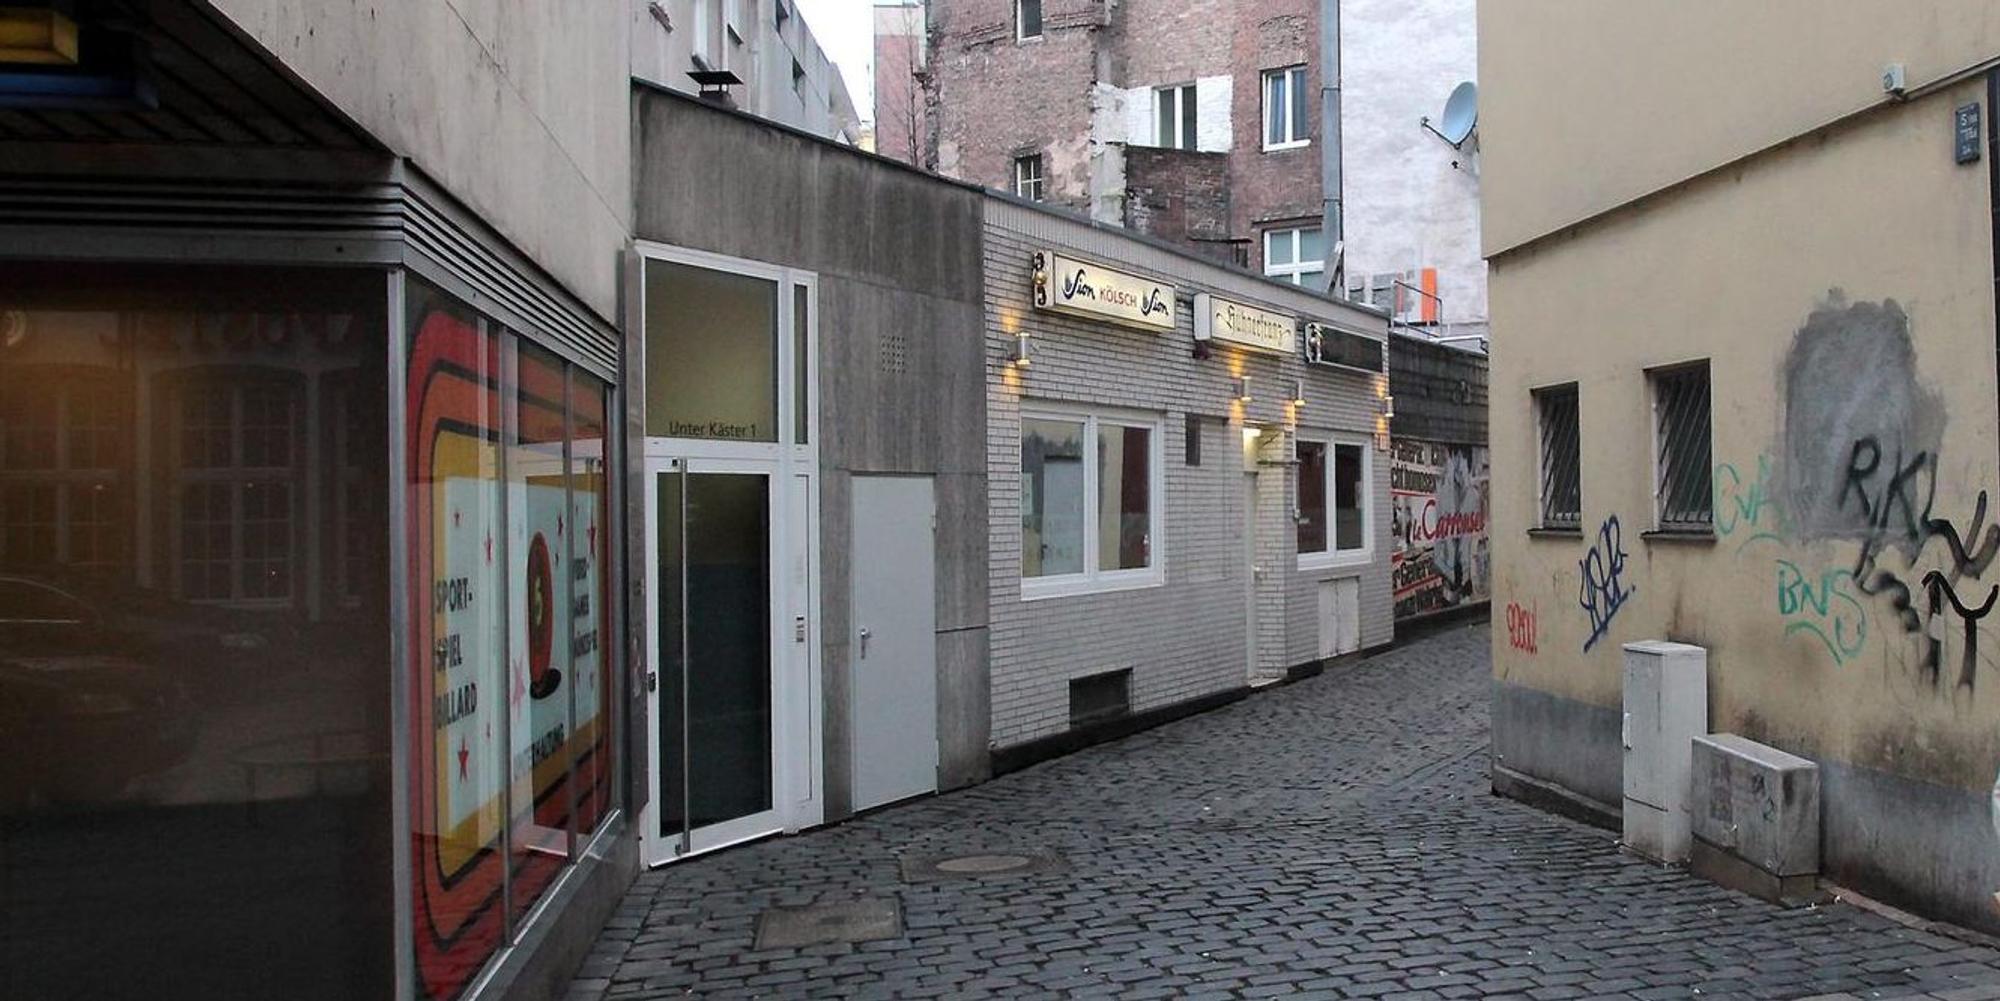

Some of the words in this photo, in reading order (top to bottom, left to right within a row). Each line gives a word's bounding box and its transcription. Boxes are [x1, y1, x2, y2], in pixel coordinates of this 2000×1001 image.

[1062, 268, 1096, 300] Sion
[1100, 285, 1137, 307] KÖLSCH
[1141, 287, 1169, 316] Sion
[669, 421, 704, 436] Unter
[709, 421, 745, 437] Käster
[750, 424, 756, 437] 1
[436, 577, 473, 614] SPORT-
[435, 682, 478, 729] BILLARD
